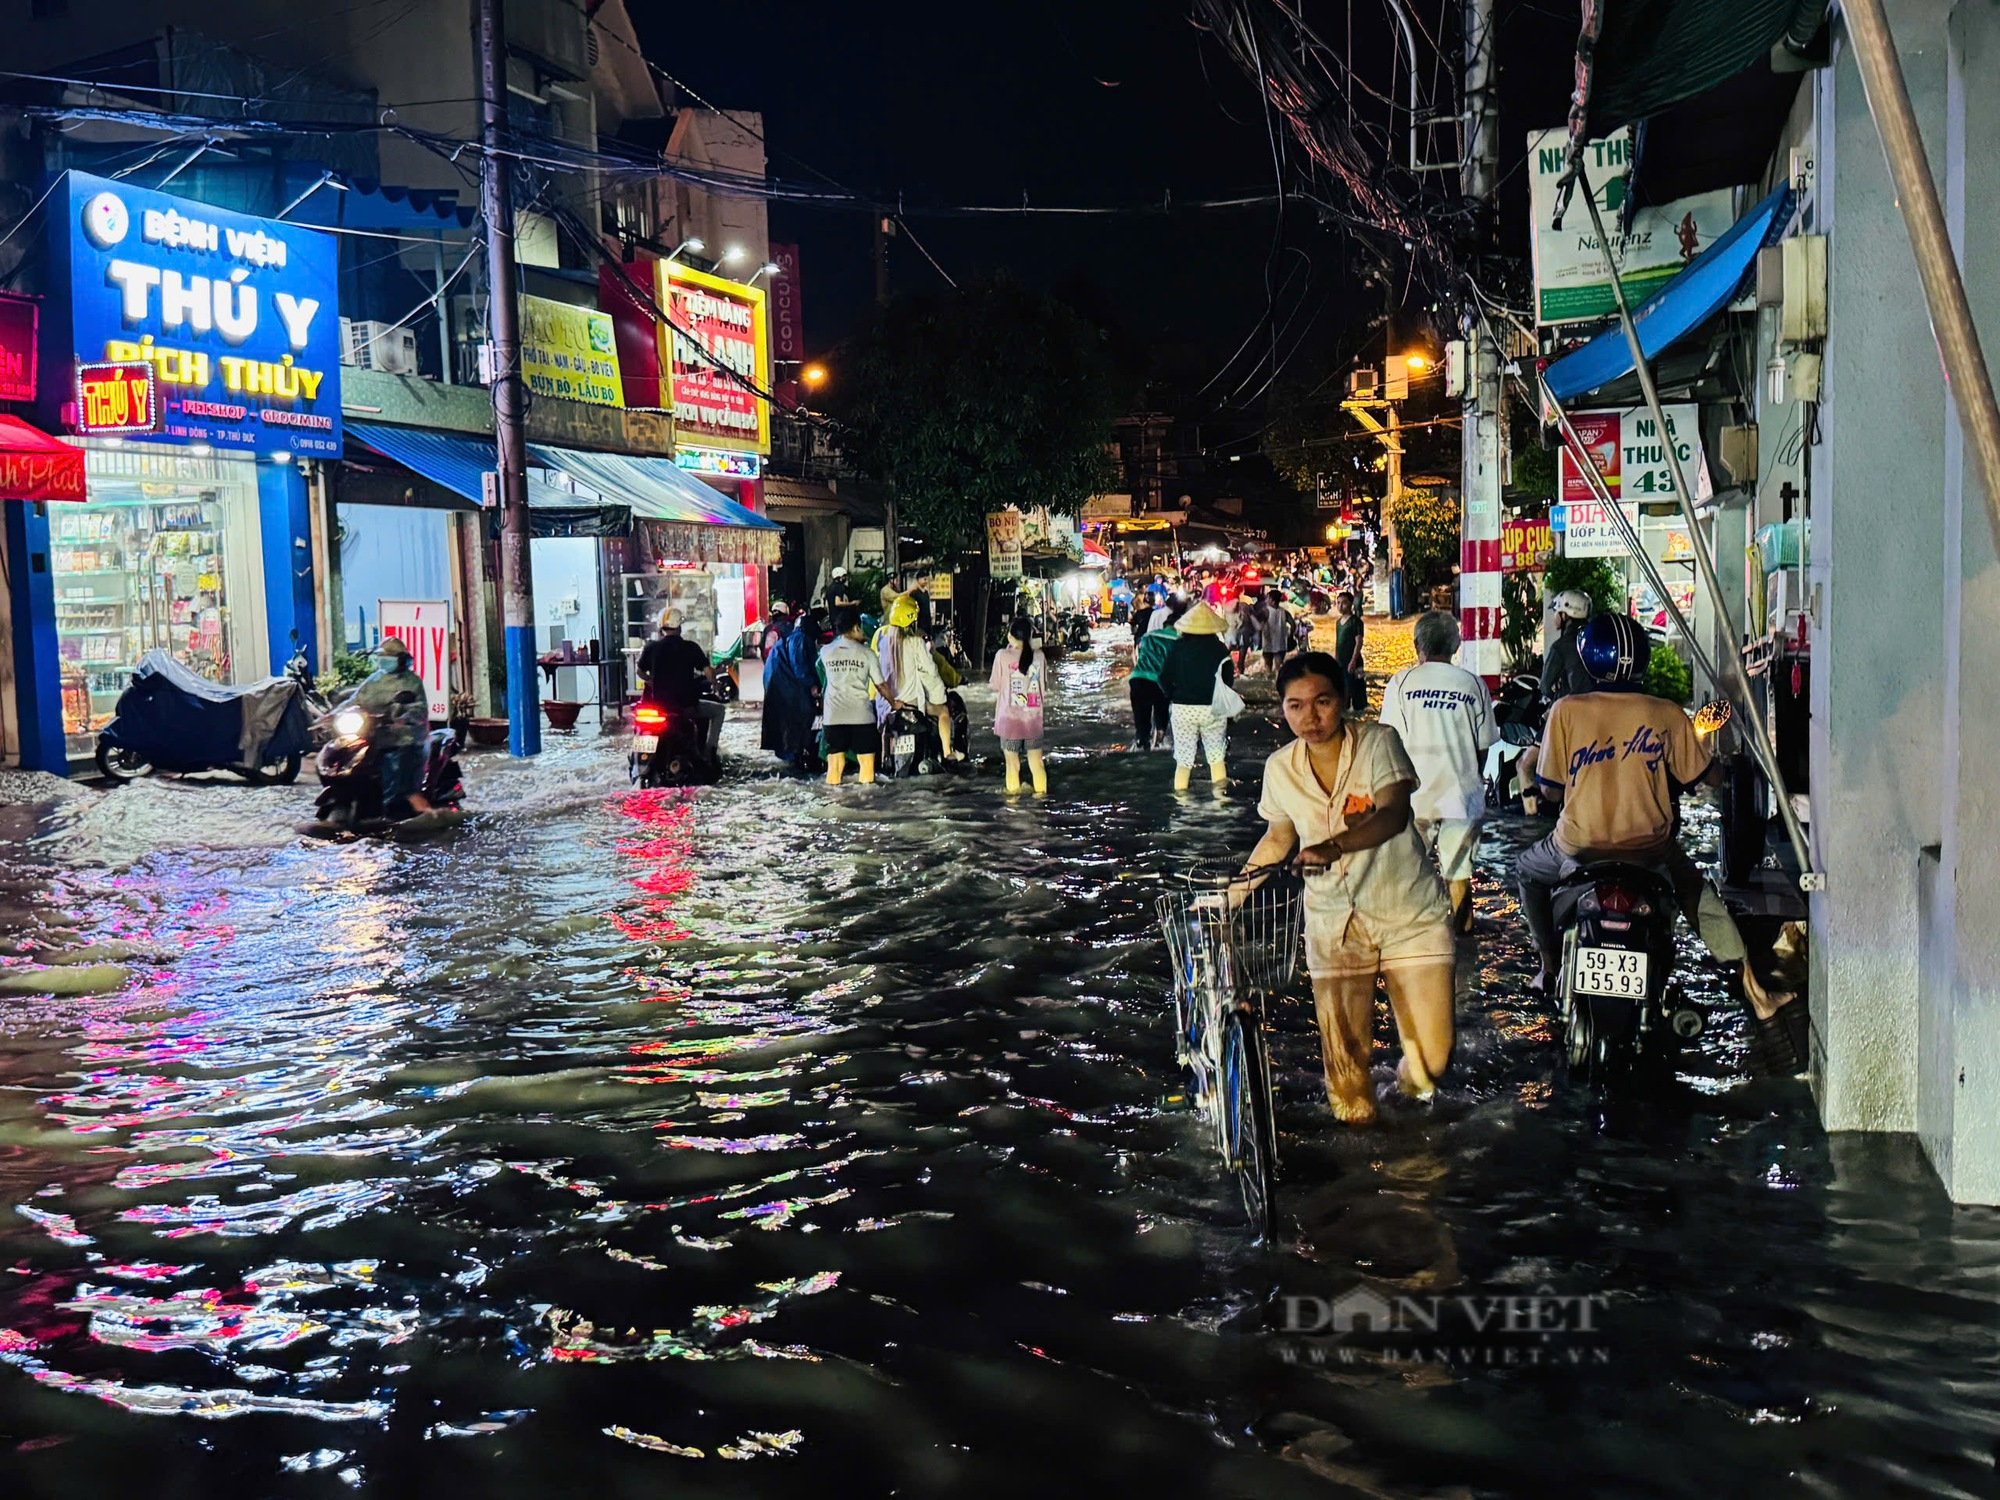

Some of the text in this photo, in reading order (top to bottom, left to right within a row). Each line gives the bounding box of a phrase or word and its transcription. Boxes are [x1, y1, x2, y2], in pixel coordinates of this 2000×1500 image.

[1539, 147, 1566, 174] NH
[143, 208, 286, 268] BỆNH VIỆN
[107, 259, 320, 347] THÚ Y
[717, 296, 751, 328] VÀNG
[713, 334, 755, 377] ANH
[220, 353, 323, 400] THỦY
[530, 372, 553, 393] BÚN
[557, 376, 571, 394] BÒ
[601, 384, 614, 401] BÒ
[83, 368, 149, 426] THÚ Y
[182, 399, 332, 430] PETSHOP GROOMING
[1633, 469, 1676, 493] 43
[1570, 503, 1606, 524] BIA
[1516, 551, 1535, 567] 88
[431, 626, 444, 691] Y
[432, 703, 445, 714] 439
[1423, 700, 1458, 711] KITA
[1578, 970, 1644, 995] 155.93
